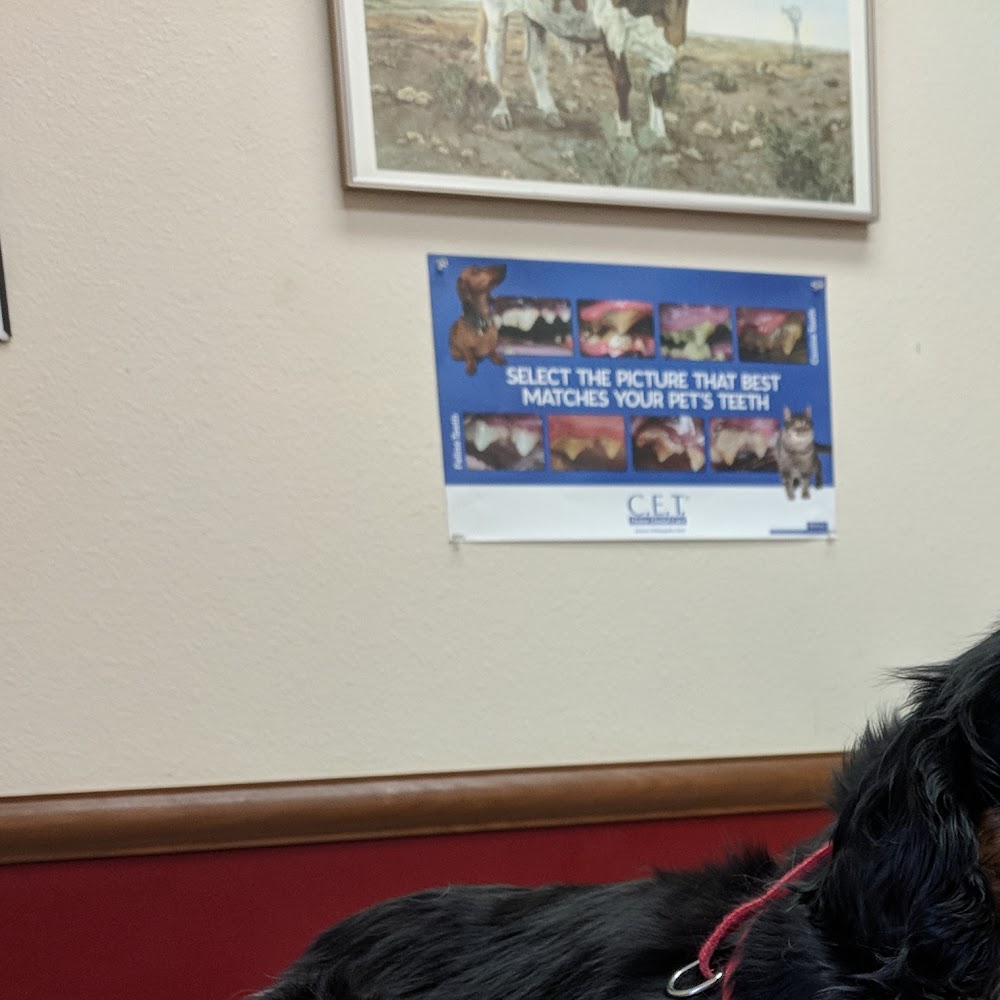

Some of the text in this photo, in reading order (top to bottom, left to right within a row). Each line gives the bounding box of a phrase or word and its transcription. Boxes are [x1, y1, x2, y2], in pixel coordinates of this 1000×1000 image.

[505, 366, 781, 392] SELECT THE PICTURE THAT BEST
[521, 387, 770, 411] MATCHES YOUR PET'S TEETH
